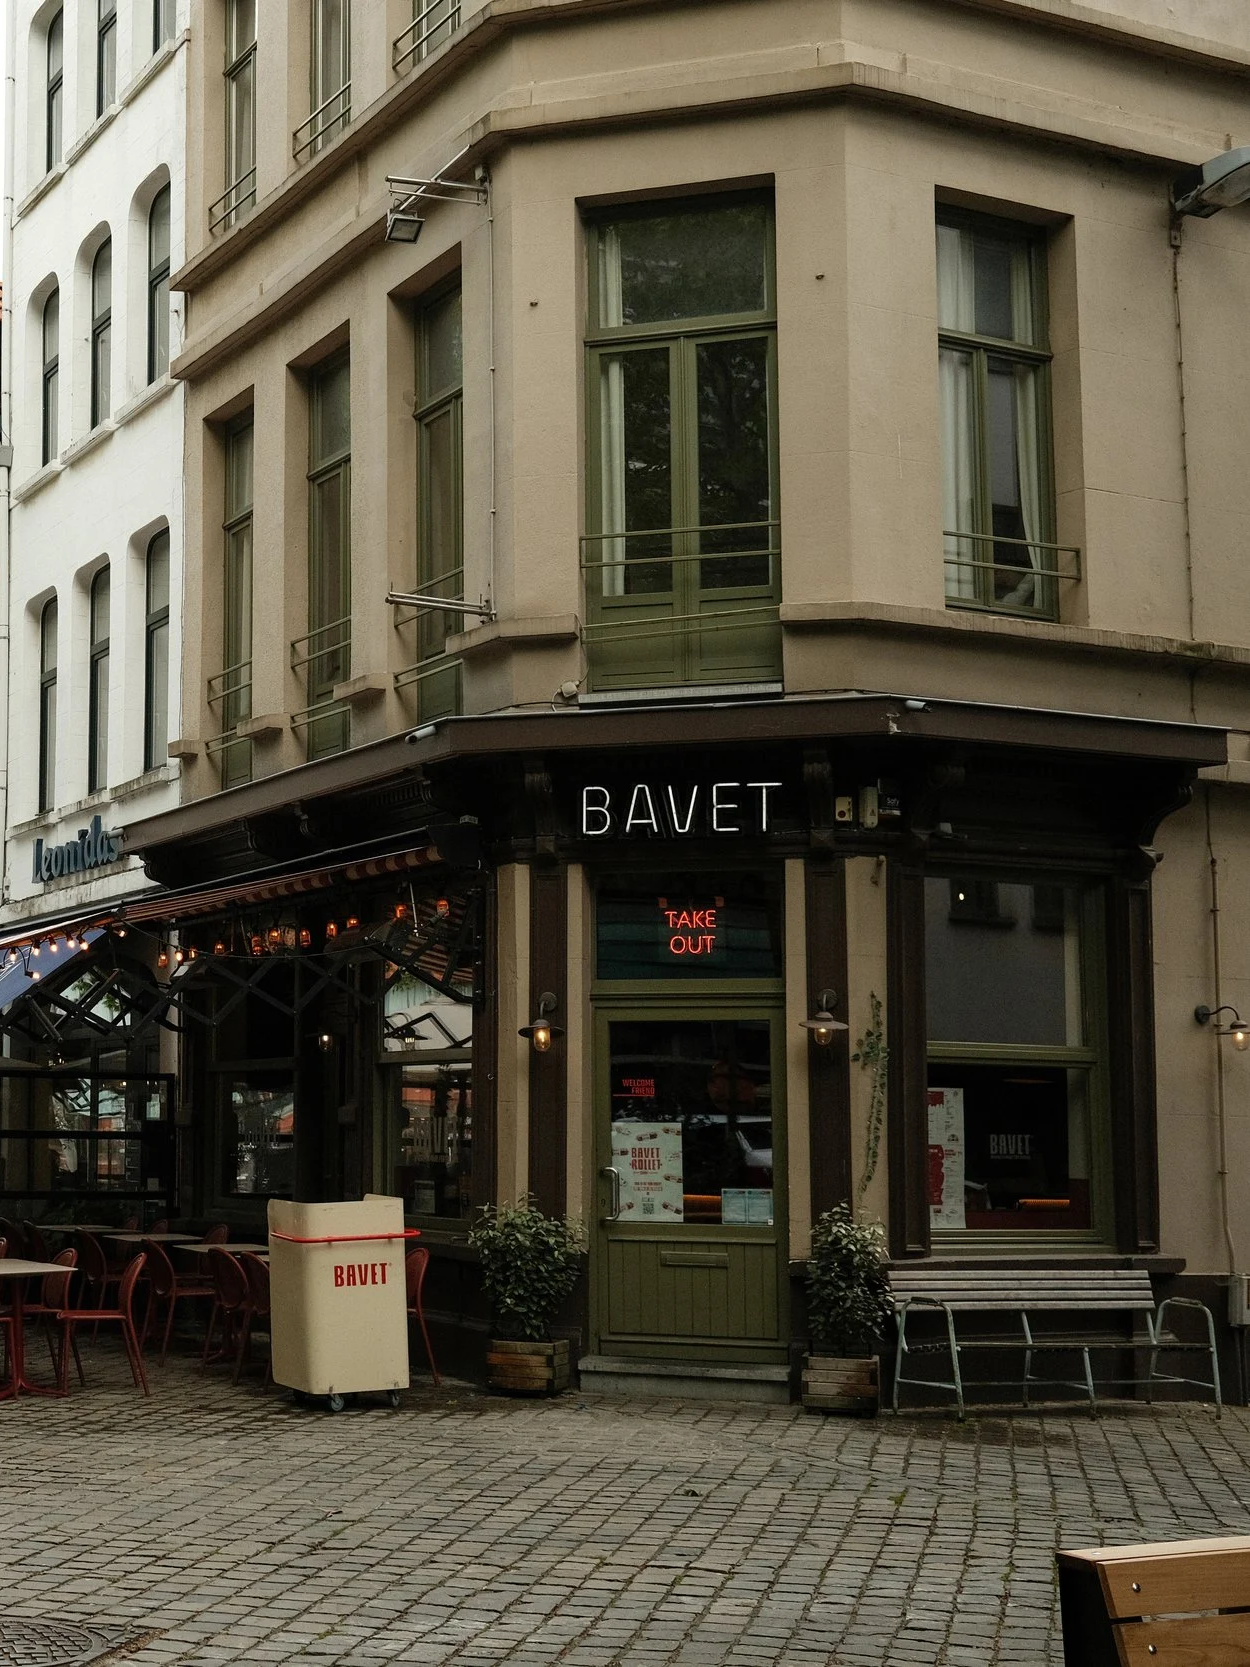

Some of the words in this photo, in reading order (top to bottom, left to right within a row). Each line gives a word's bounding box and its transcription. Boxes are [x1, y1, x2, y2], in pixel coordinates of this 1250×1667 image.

[582, 781, 783, 835] BAVET
[32, 815, 123, 884] Leonidas
[664, 909, 717, 929] TAKE
[669, 935, 716, 954] OUT
[622, 1079, 655, 1087] WELCOME
[631, 1087, 655, 1095] FRIEND
[631, 1147, 661, 1159] BAVET
[989, 1133, 1031, 1155] BAVET
[333, 1262, 388, 1288] BAVET
